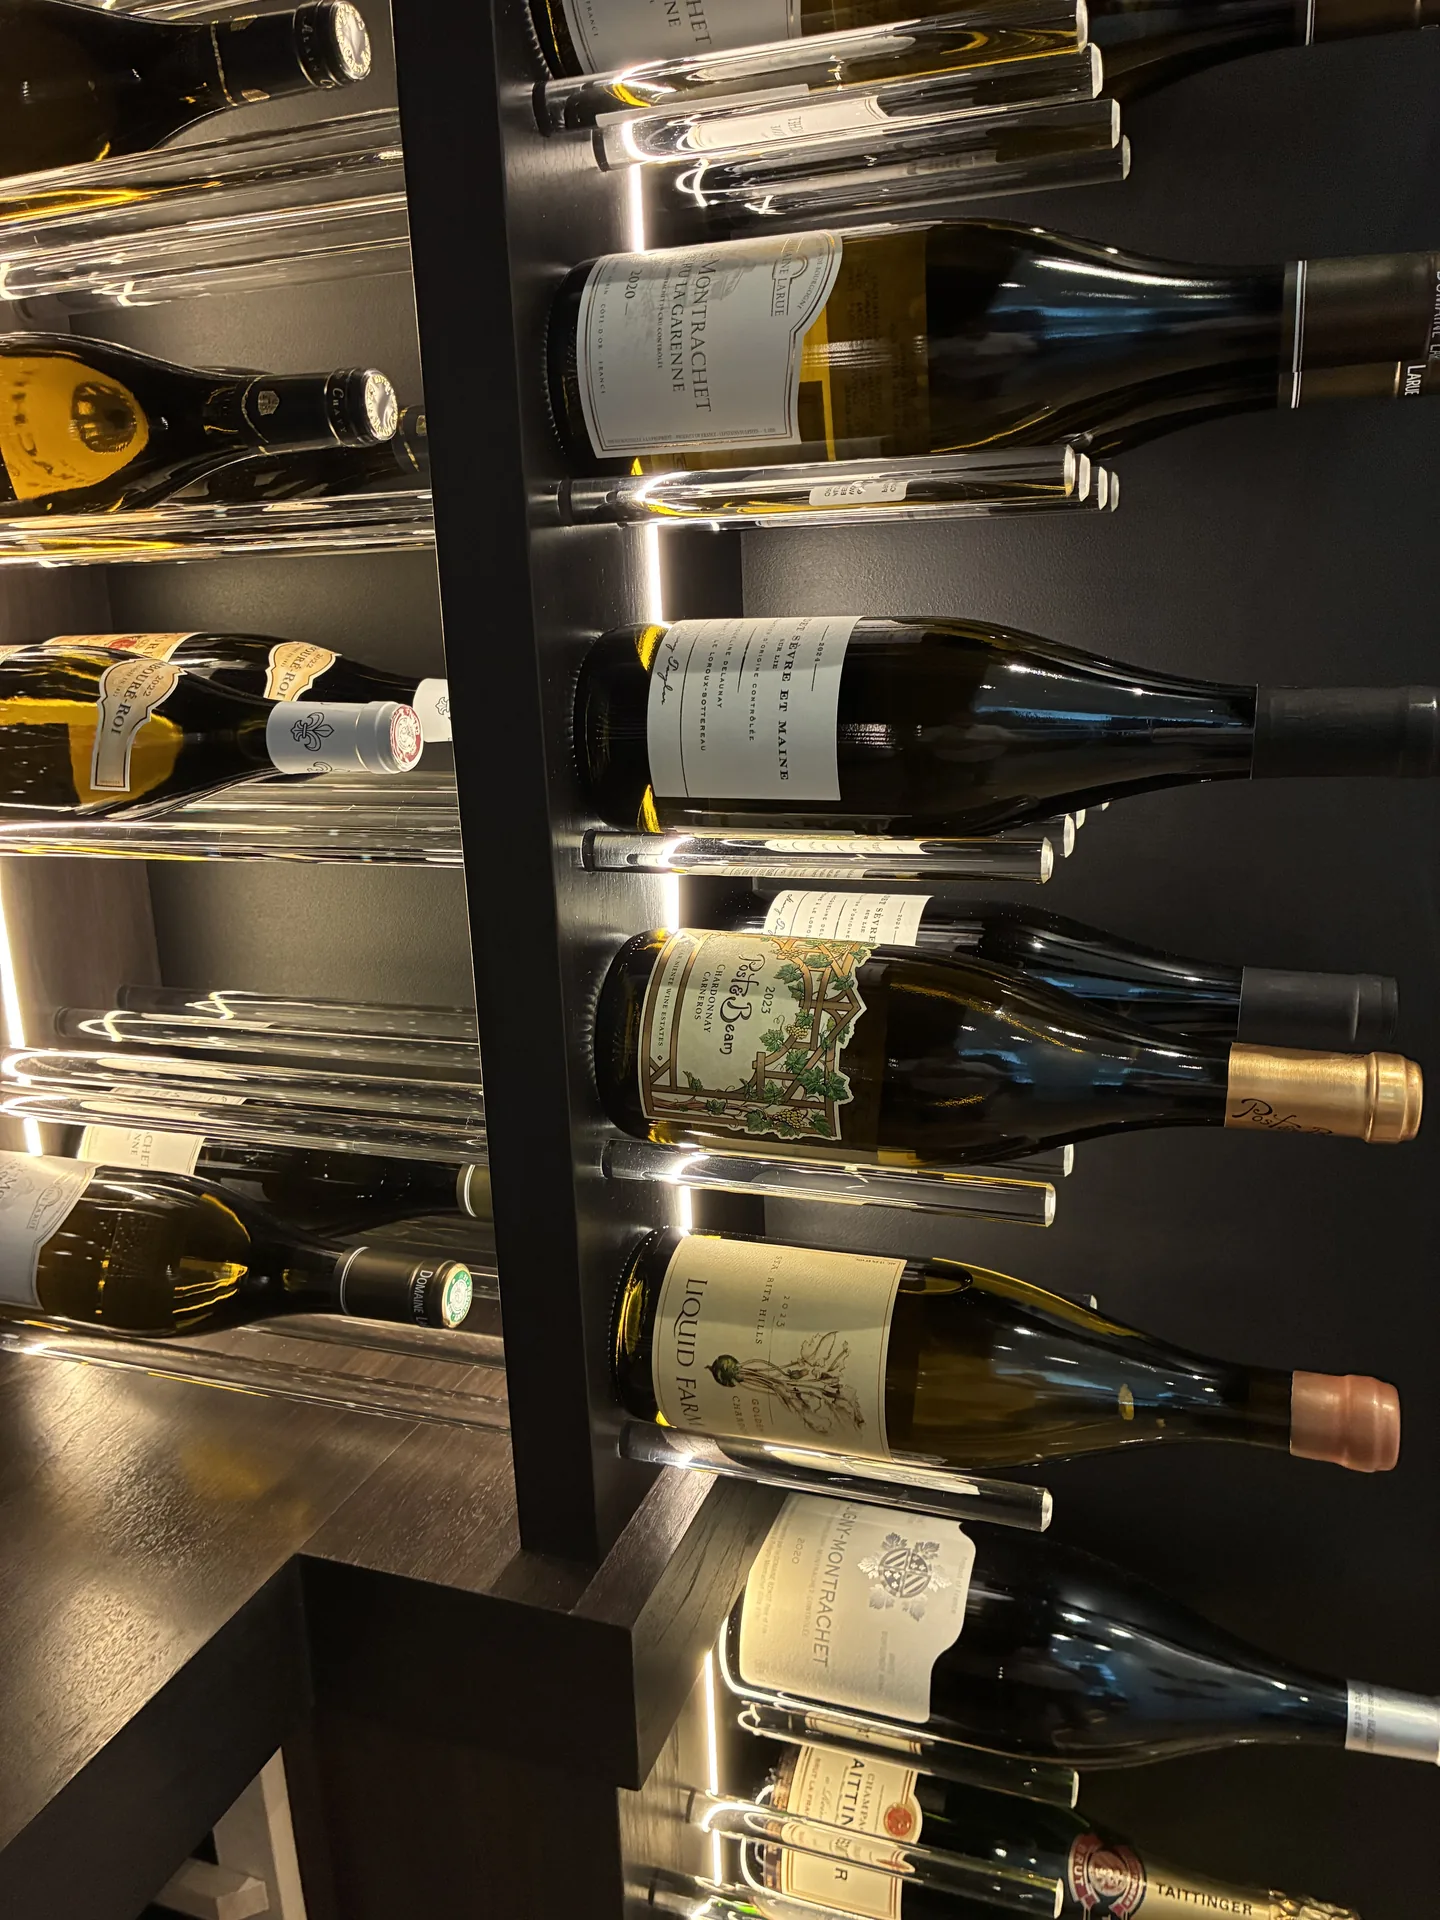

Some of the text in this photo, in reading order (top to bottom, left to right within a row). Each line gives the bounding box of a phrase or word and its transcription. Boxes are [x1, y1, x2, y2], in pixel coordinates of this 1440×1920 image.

[624, 269, 642, 299] 2020
[672, 282, 688, 300] LA
[774, 278, 788, 317] LARUE
[669, 304, 685, 393] GARENNE
[597, 360, 606, 395] FRANCE
[1404, 364, 1427, 396] LARUE
[771, 638, 786, 670] SUR LIE
[813, 642, 826, 662] 2024
[142, 675, 164, 698] 2022
[656, 656, 681, 706] Taylor
[716, 660, 729, 709] DELAUNAY
[748, 638, 769, 742] D'ORIGINE CONTRÔLÉE
[777, 635, 802, 781] SÈVRE ET MAINE
[866, 907, 884, 944] SÈVRE
[667, 961, 681, 985] NIENTE
[662, 988, 673, 1009] WINE
[694, 971, 711, 1020] CARNEROS
[703, 963, 726, 1033] CHARDONNAY
[761, 986, 776, 1014] 2023
[657, 1011, 667, 1047] ESTATES
[413, 1270, 434, 1314] DOMAINE
[761, 1277, 776, 1303] RITA
[754, 1309, 767, 1345] HILLS
[775, 1295, 790, 1328] 2023
[673, 1278, 708, 1429] LIQUID FARM
[791, 1538, 806, 1565] 2020
[1072, 1844, 1085, 1887] BRUT
[1155, 1883, 1253, 1915] TAITTINGER
